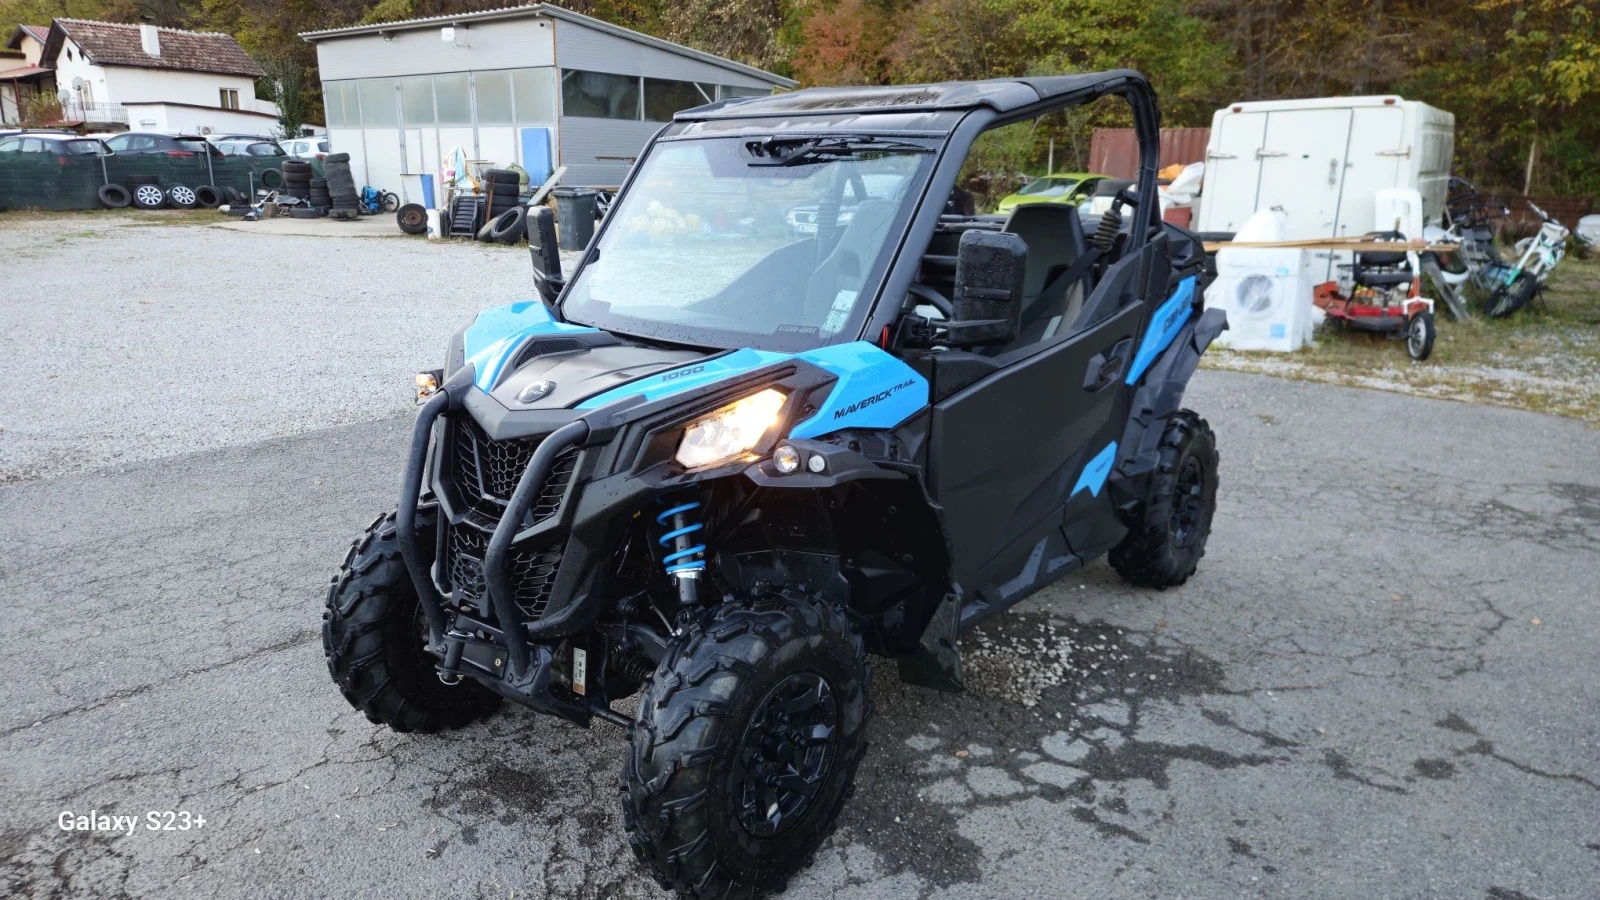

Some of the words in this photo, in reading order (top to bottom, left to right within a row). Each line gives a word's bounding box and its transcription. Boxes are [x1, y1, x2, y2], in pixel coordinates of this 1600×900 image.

[662, 365, 705, 381] 1000
[834, 388, 892, 420] MAVERICK
[893, 379, 916, 393] TRAIL
